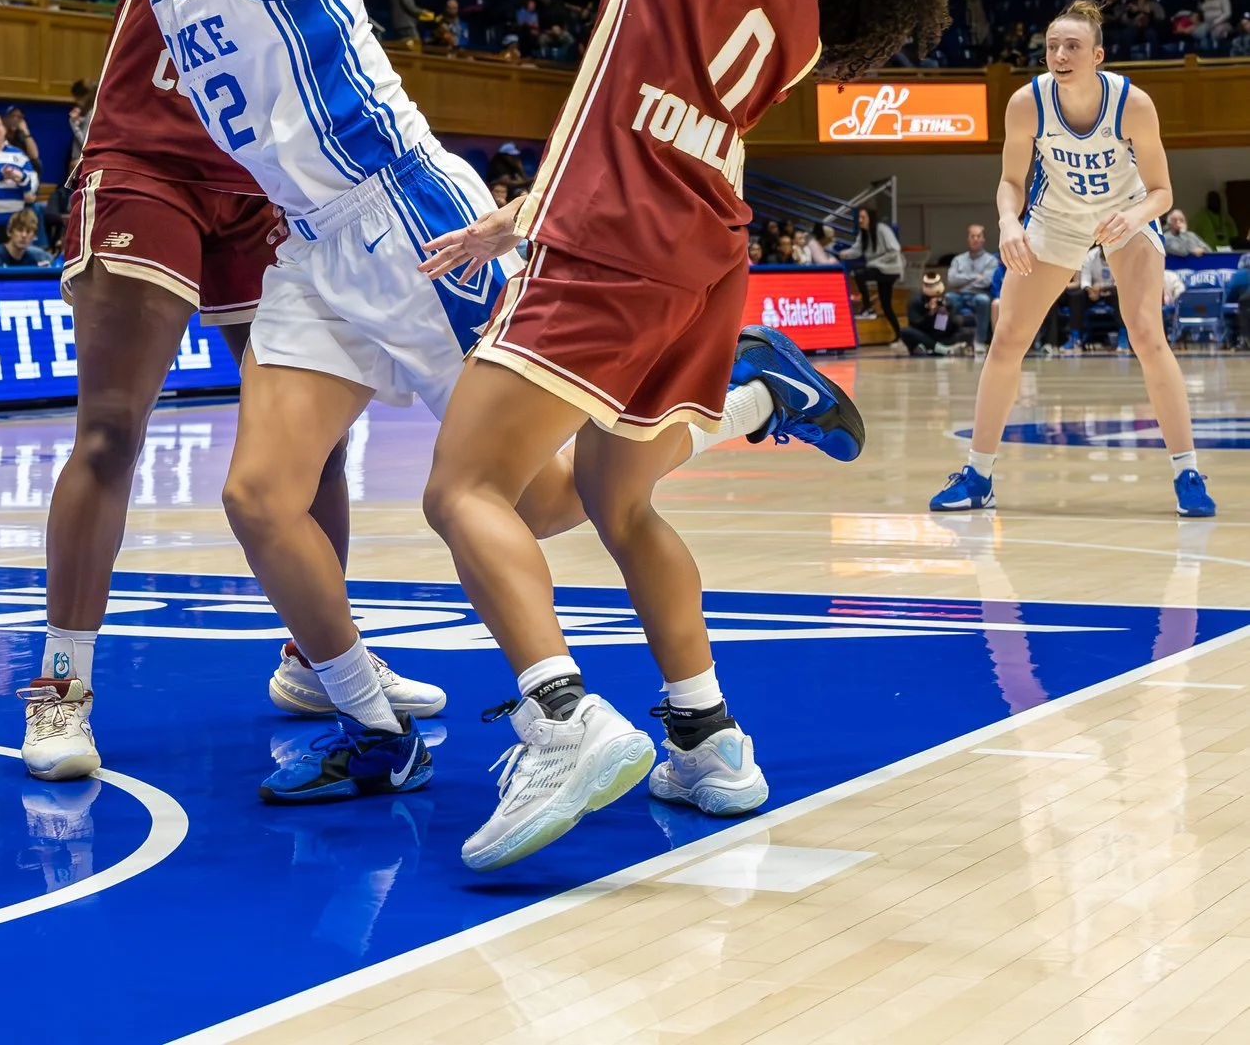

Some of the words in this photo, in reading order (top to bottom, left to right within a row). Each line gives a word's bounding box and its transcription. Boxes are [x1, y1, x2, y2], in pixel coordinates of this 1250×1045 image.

[707, 7, 777, 113] 0
[910, 118, 957, 133] STIHL
[1052, 147, 1116, 170] DUKE
[1066, 171, 1111, 197] 35
